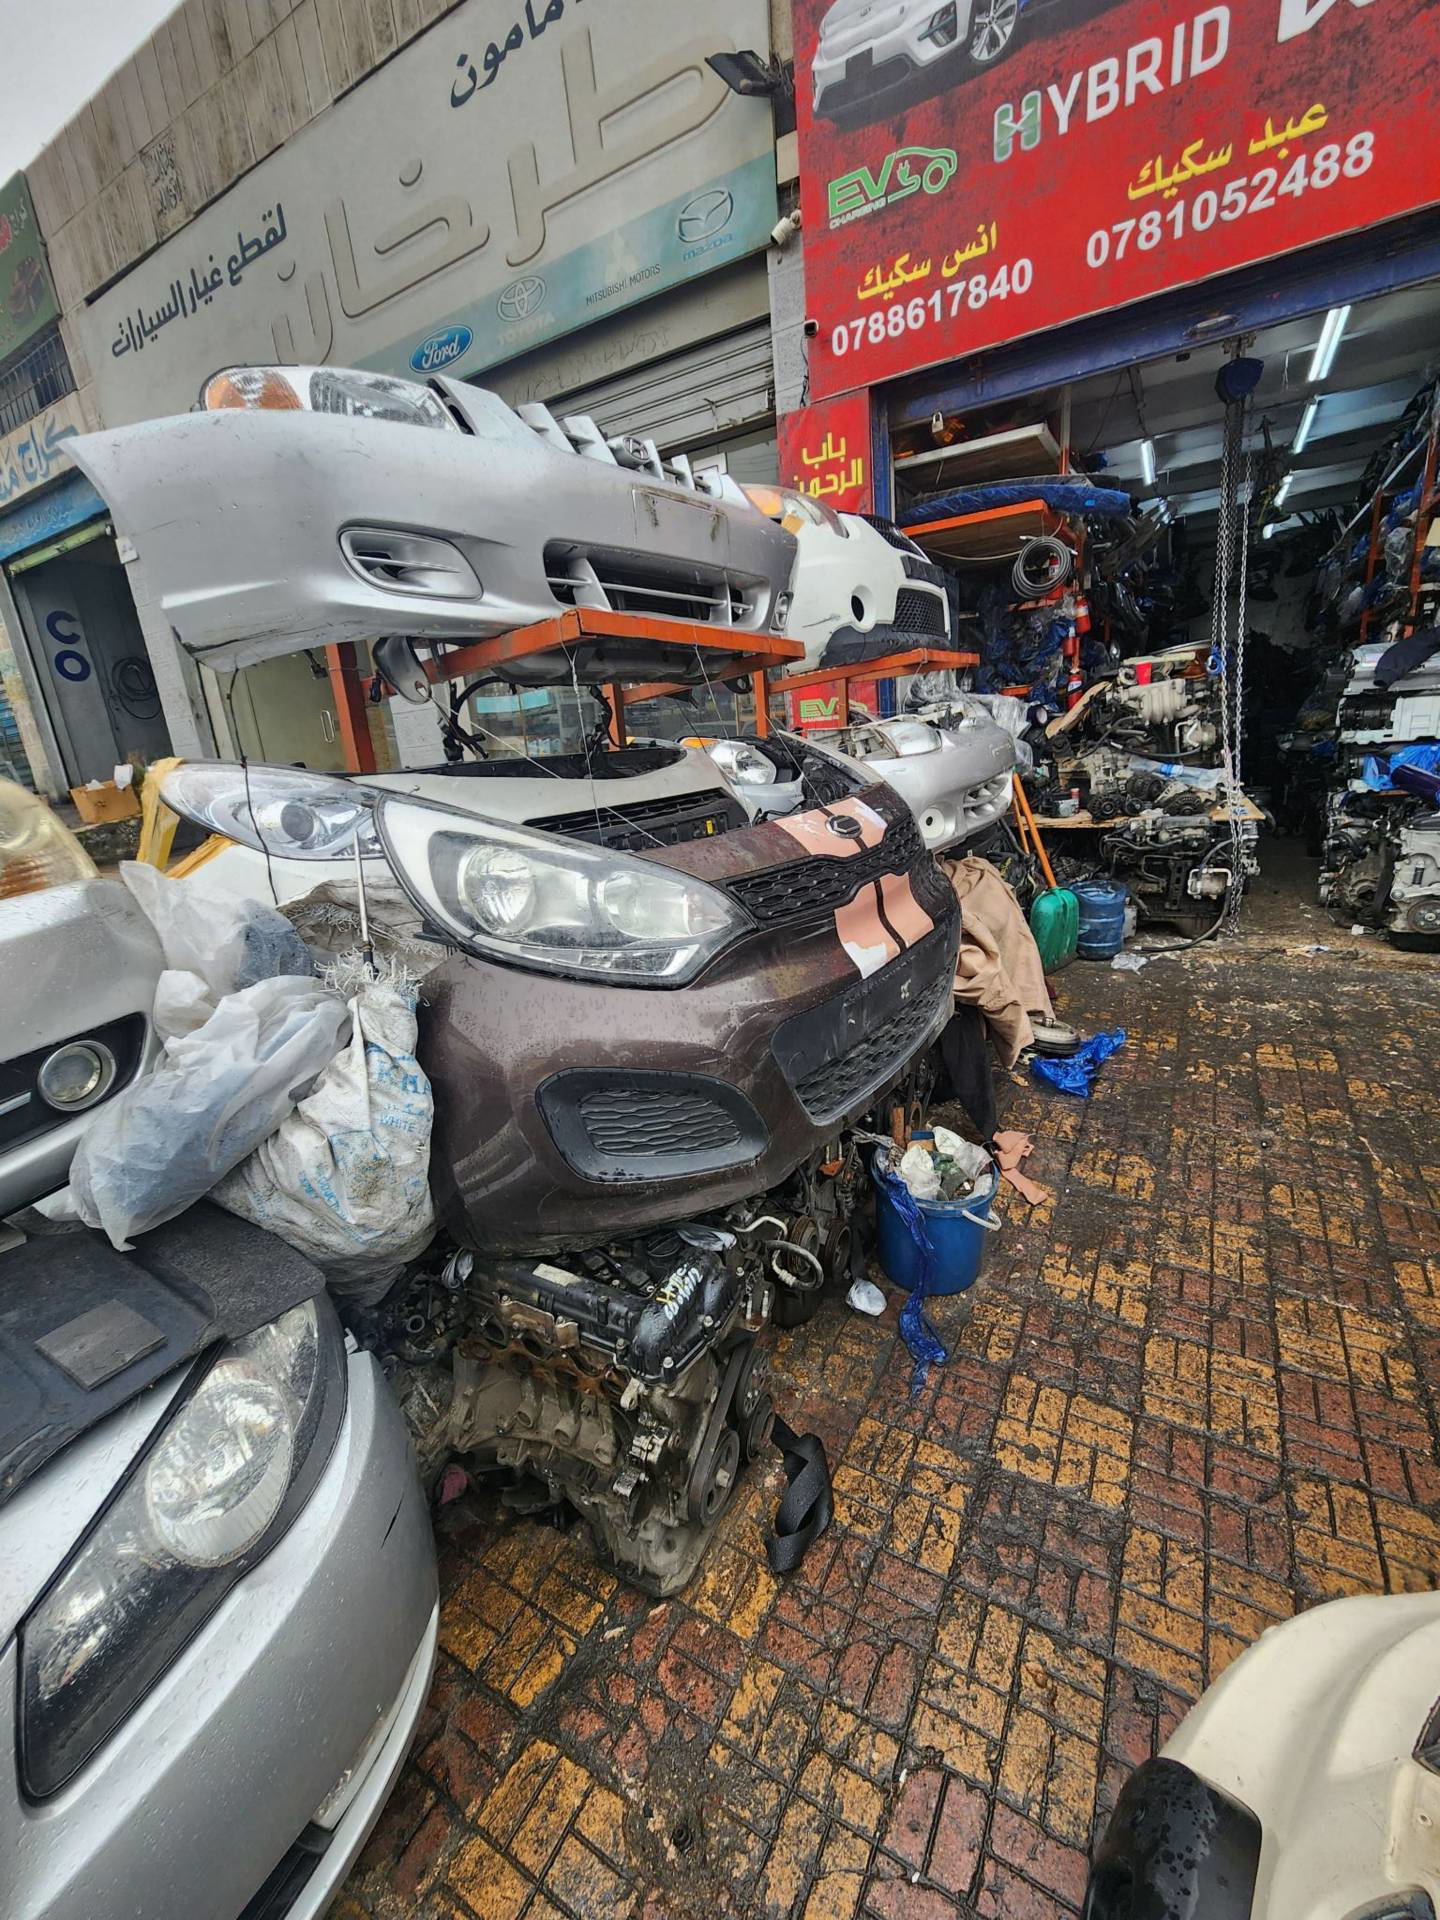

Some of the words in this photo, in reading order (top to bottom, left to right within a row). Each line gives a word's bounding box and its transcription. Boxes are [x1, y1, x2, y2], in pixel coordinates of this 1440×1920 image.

[993, 5, 1230, 163] HYBRID
[1248, 103, 1328, 159] عبد
[828, 152, 897, 219] EV
[1128, 138, 1232, 200] سكيك
[1086, 131, 1374, 268] 0781052488
[228, 203, 288, 286] لقطع
[682, 232, 734, 263] mazda
[941, 220, 998, 277] انس
[188, 254, 224, 314] غيار
[586, 281, 627, 306] MITSUBISHI
[629, 263, 661, 287] MOTORS
[857, 252, 931, 300] سكيك
[111, 280, 187, 358] السيارات
[831, 257, 1033, 357] 0788617840
[421, 333, 461, 369] Ford
[802, 431, 846, 470] باب
